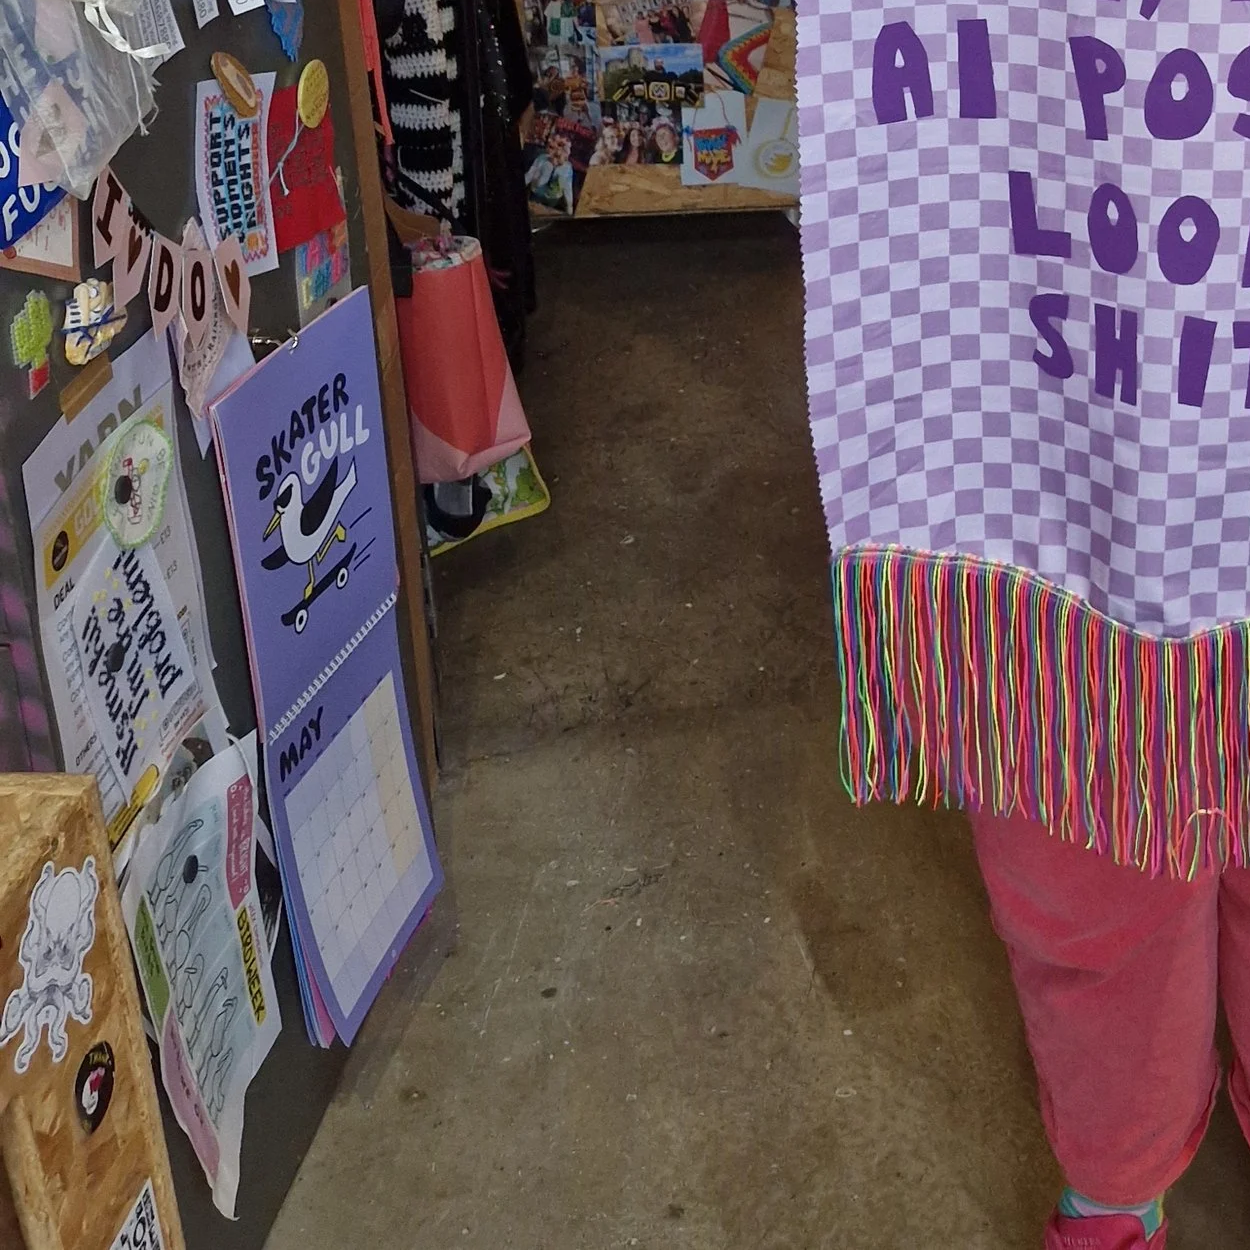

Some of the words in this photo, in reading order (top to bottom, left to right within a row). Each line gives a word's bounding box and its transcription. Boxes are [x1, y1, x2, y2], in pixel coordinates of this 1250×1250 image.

[872, 19, 997, 125] AI
[208, 111, 232, 241] SUPPORT
[256, 373, 350, 500] SKATER
[301, 404, 370, 486] GULL
[53, 577, 76, 611] DEAL
[75, 733, 98, 768] OTHERS
[279, 706, 324, 783] MAY
